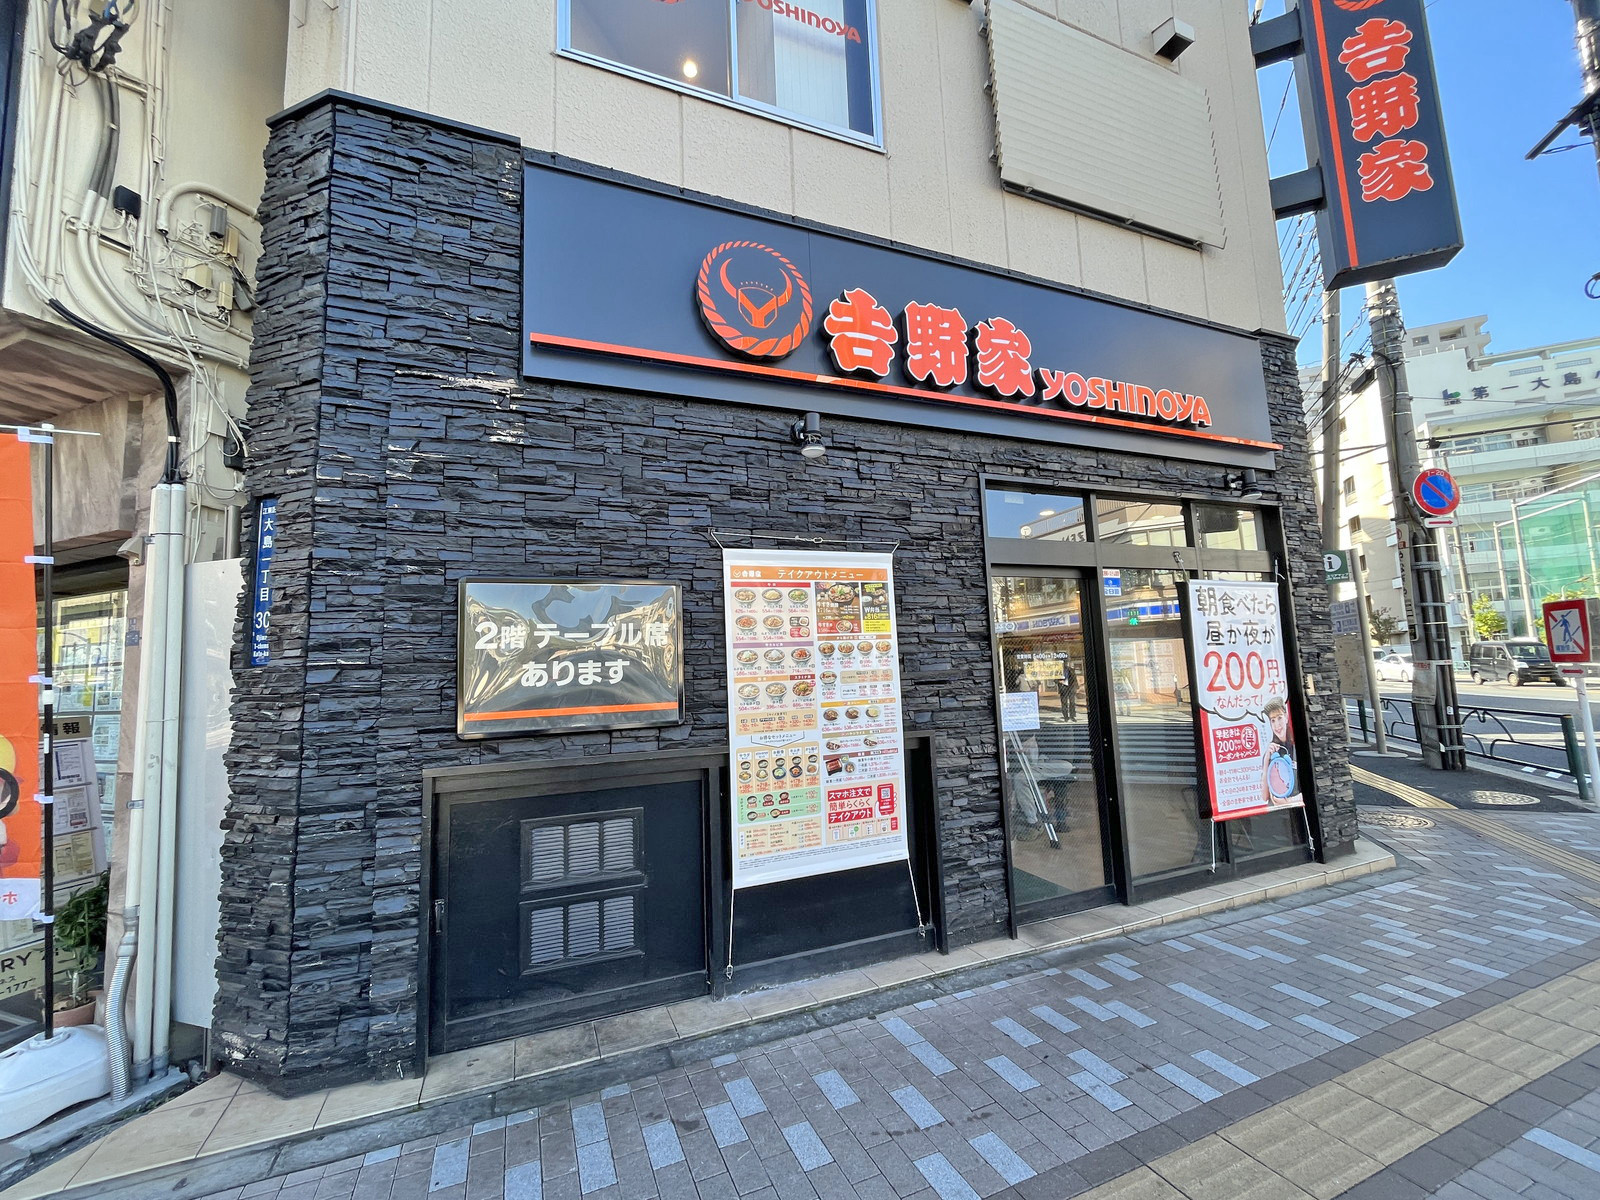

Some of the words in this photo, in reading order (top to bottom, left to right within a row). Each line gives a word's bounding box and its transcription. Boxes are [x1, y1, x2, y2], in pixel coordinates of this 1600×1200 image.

[742, 0, 861, 44] OSHINOYA
[1338, 18, 1434, 202] 吉野家
[824, 287, 1036, 398] 吉野家
[1041, 367, 1213, 427] YOSHINOYA
[1471, 370, 1600, 400] 第一大島
[1425, 469, 1445, 477] 7-20
[259, 518, 274, 602] 大島一丁目
[777, 569, 864, 580] テイクアウトメニュー
[1195, 585, 1277, 617] 朝食べたら
[1206, 619, 1276, 647] 昼か夜が
[520, 658, 631, 688] あります
[1216, 694, 1264, 709] なんだって!
[1215, 727, 1241, 740] 早起きは
[1218, 748, 1259, 762] クーポンキャンペーン
[828, 787, 871, 800] スマホ注文で
[829, 798, 871, 811] 簡単らくらく
[829, 808, 872, 823] テイクアウト
